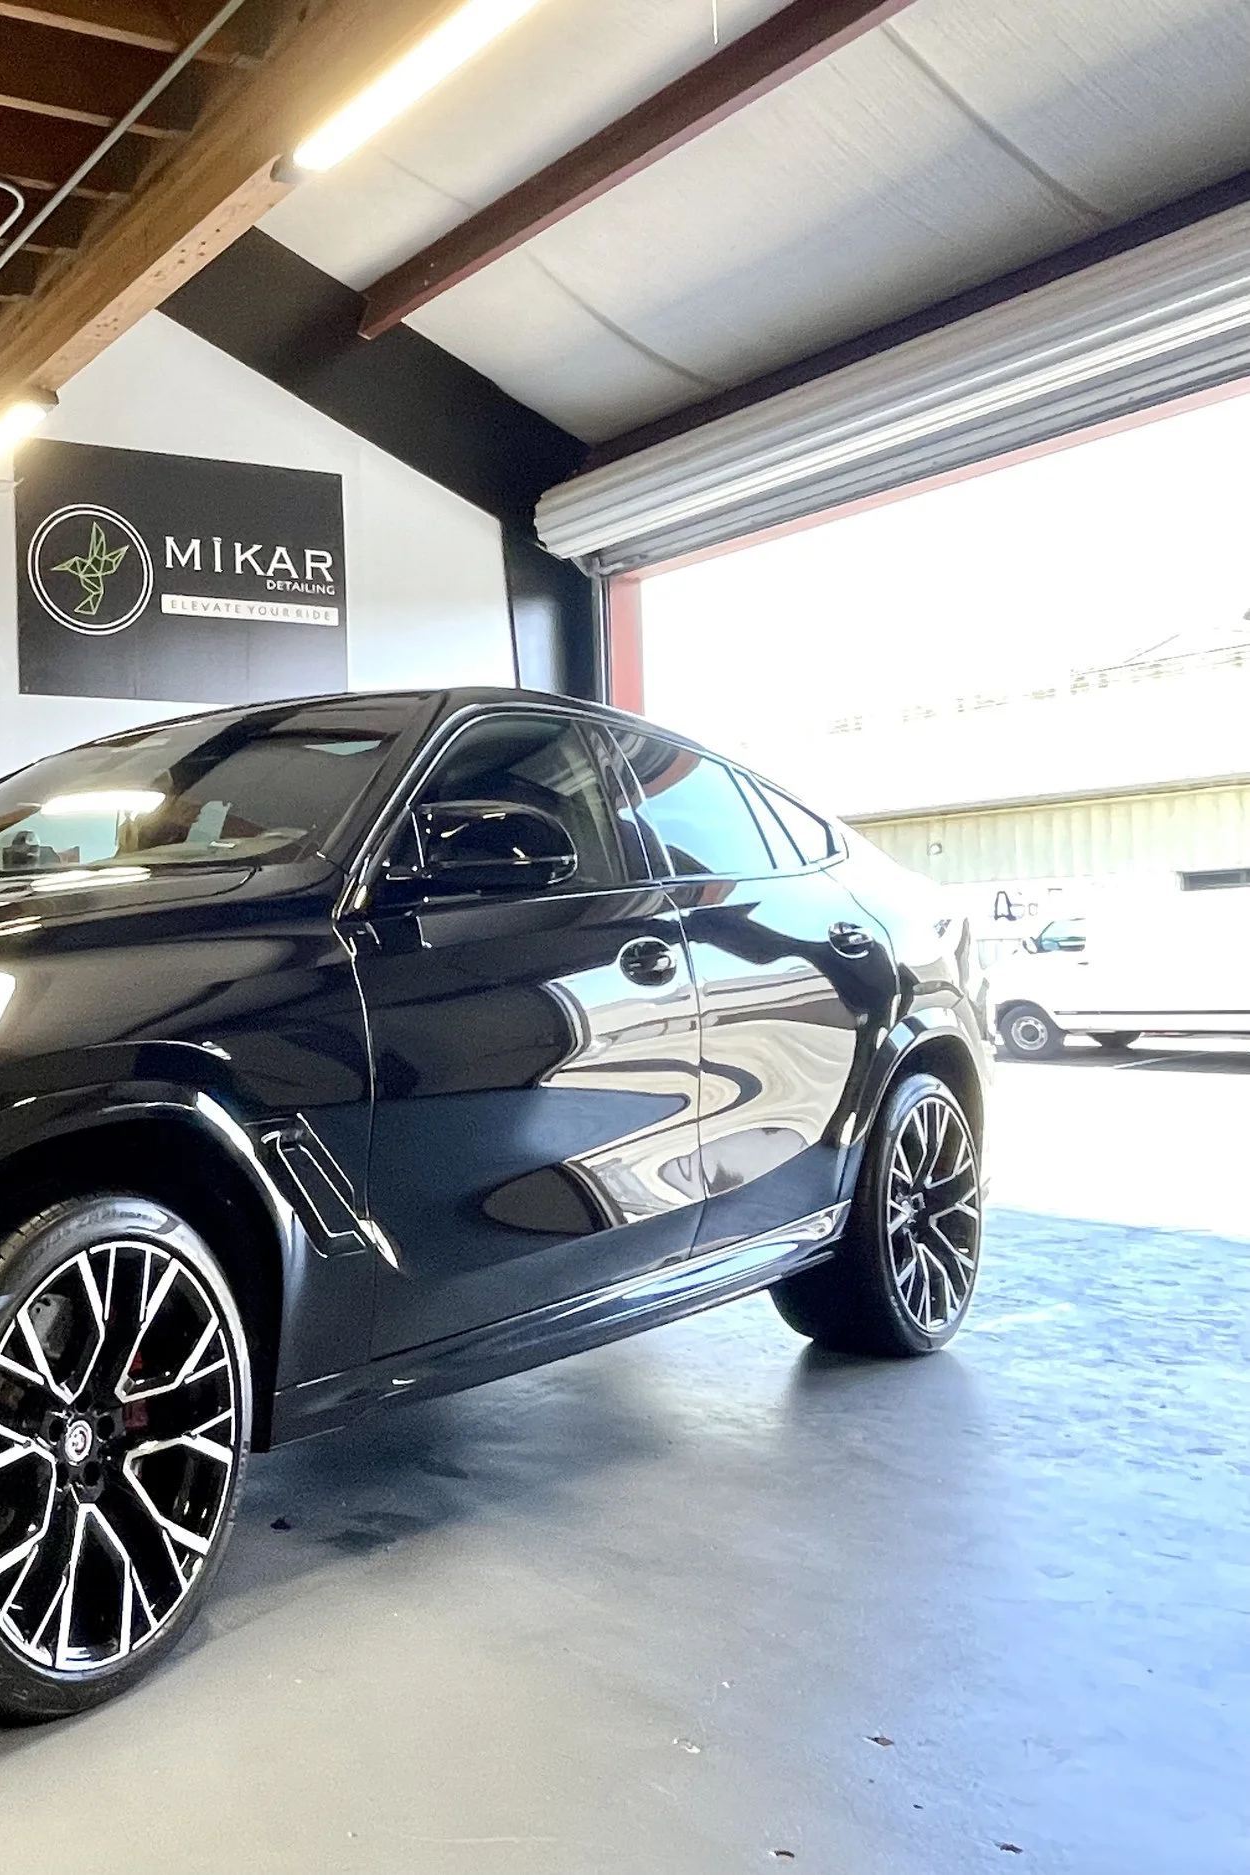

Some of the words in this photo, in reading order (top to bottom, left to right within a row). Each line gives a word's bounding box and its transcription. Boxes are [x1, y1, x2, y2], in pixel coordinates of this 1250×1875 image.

[266, 579, 336, 596] DETAILING
[171, 599, 241, 614] ELEVATE
[245, 606, 290, 618] YOUR
[295, 609, 331, 621] RIDE
